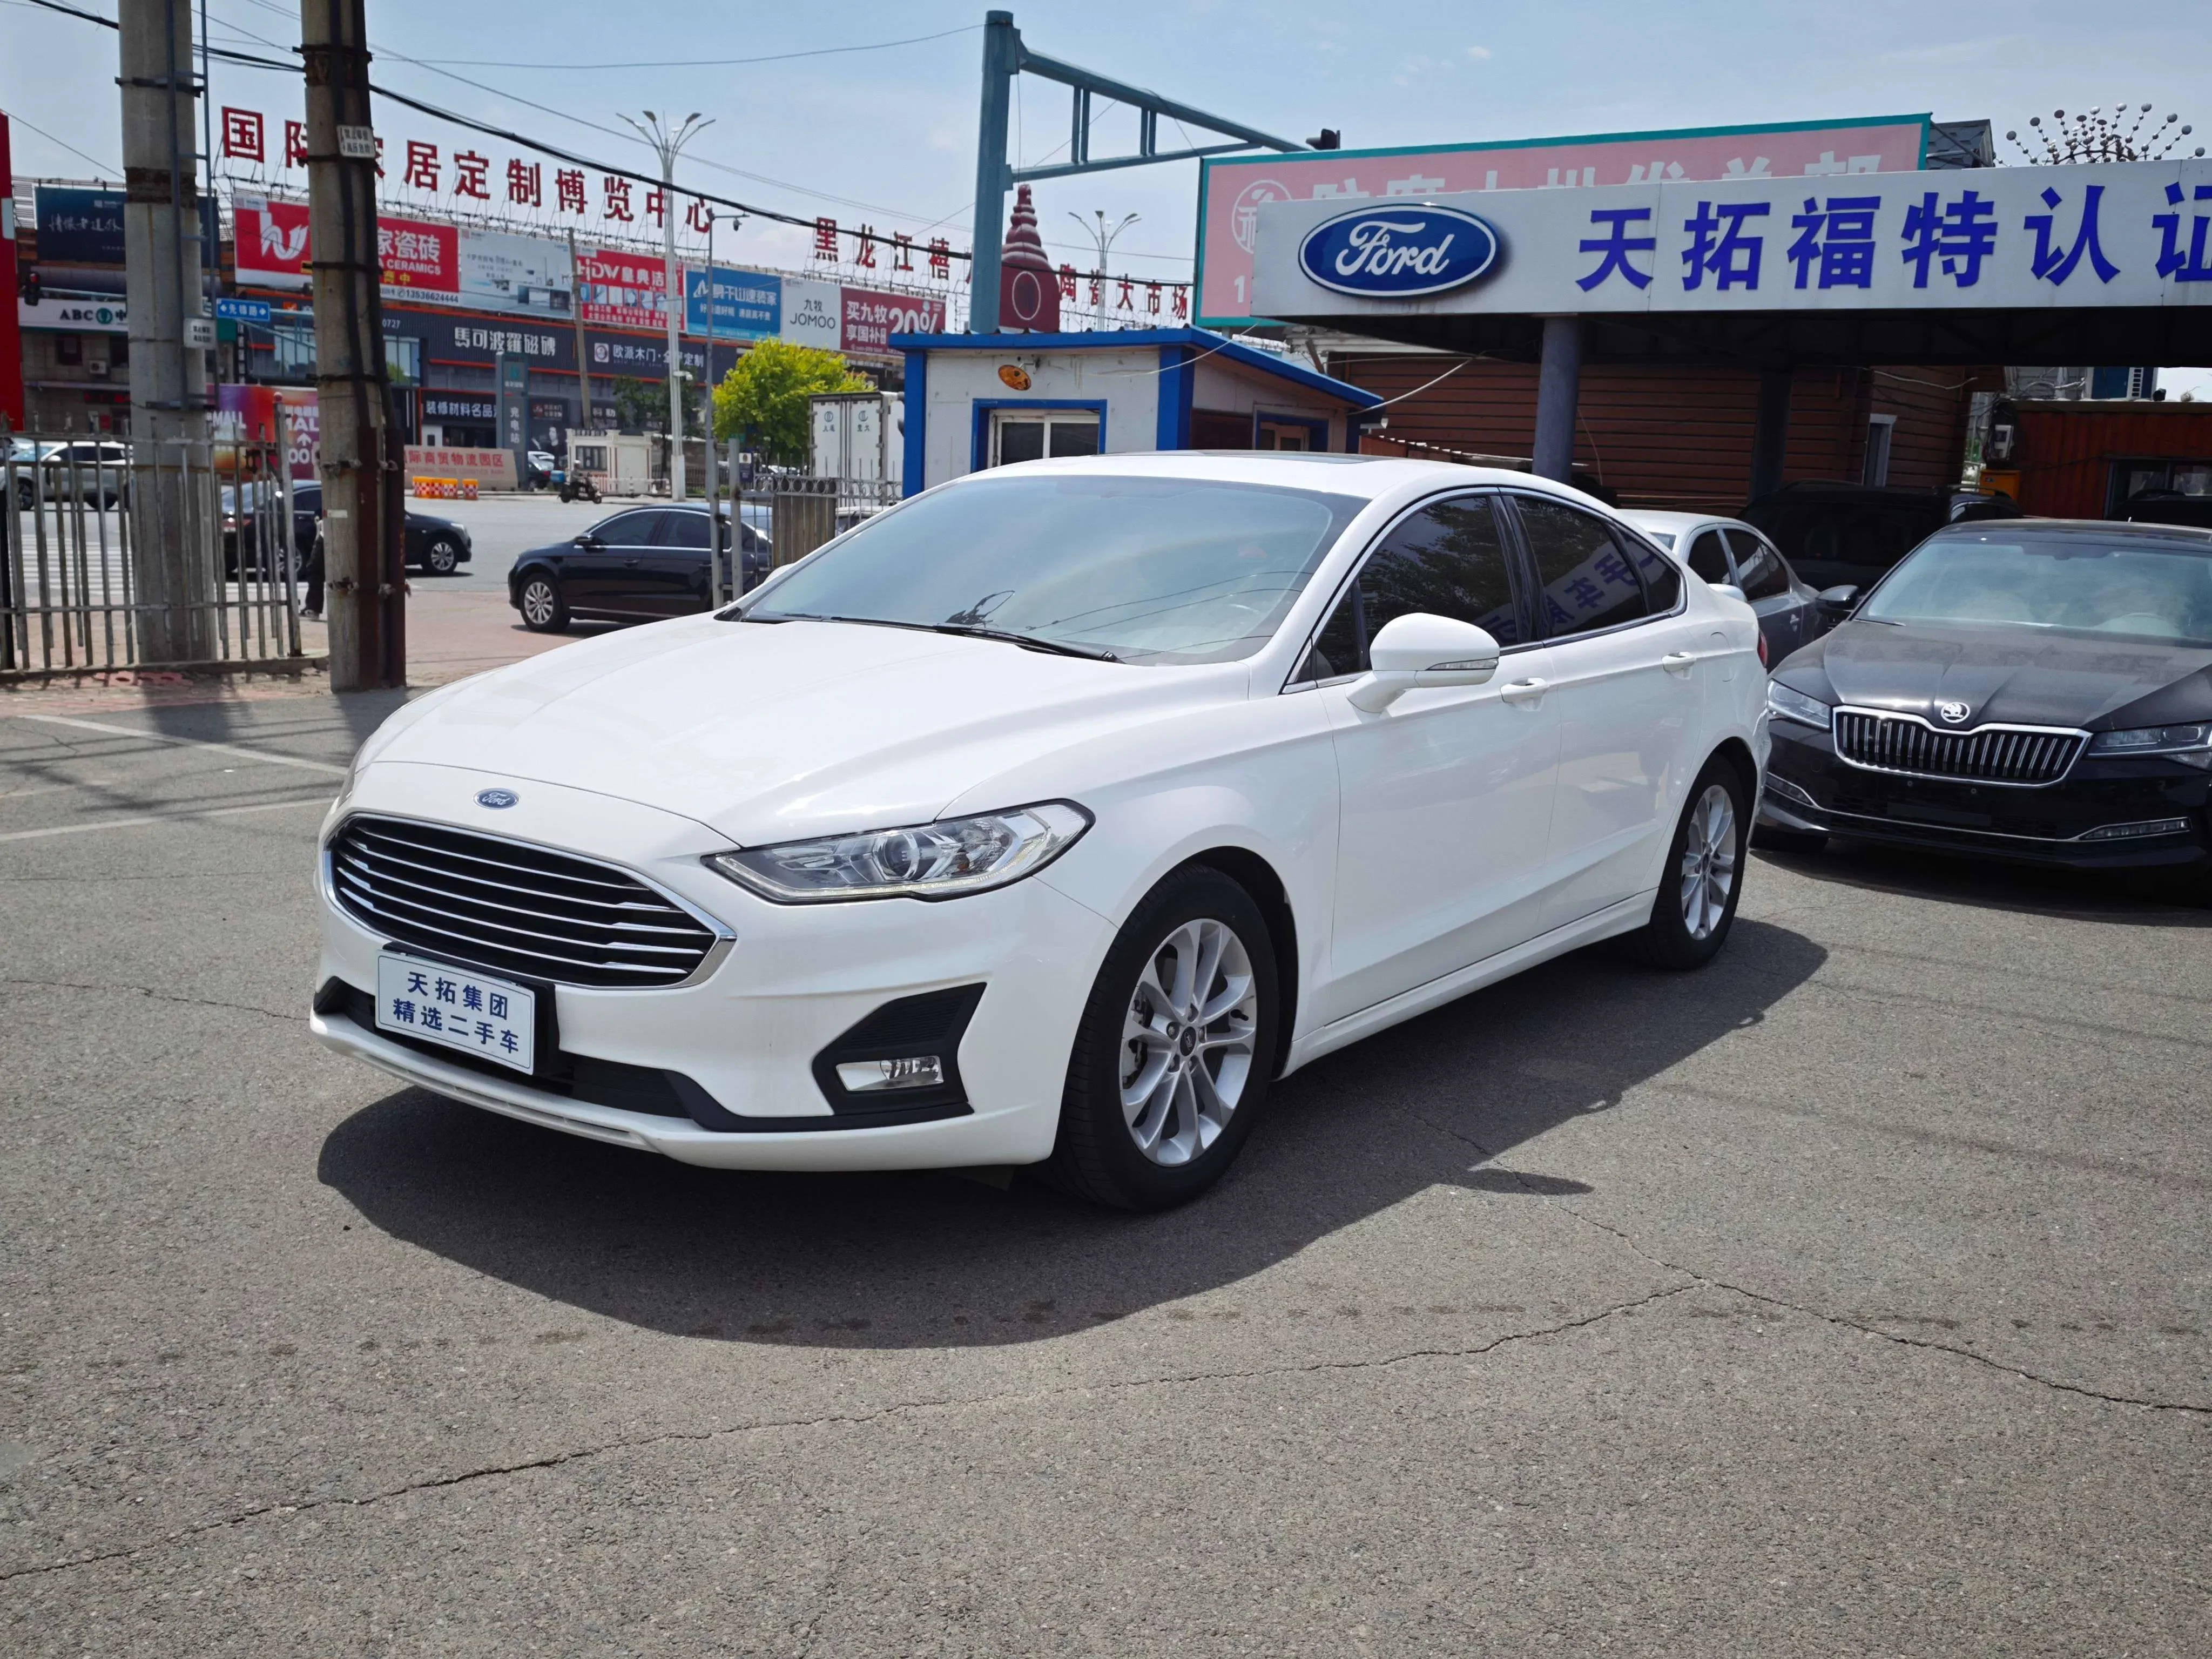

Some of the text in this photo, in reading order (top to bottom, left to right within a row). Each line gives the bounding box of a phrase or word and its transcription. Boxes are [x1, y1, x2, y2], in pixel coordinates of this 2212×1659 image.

[1575, 182, 2212, 292] 天拓福特认证
[815, 217, 972, 284] 黑龙江禧
[1336, 220, 1455, 275] Ford
[387, 259, 441, 275] CERAMICS
[60, 309, 93, 321] ABC
[804, 299, 823, 312] 九牧
[847, 301, 887, 324] 买九牧
[790, 313, 835, 329] JOMOO
[426, 400, 496, 417] 装修材料名品
[482, 792, 511, 805] Ford
[408, 971, 508, 1021] 天拓集团
[393, 998, 519, 1055] 精选二手车
